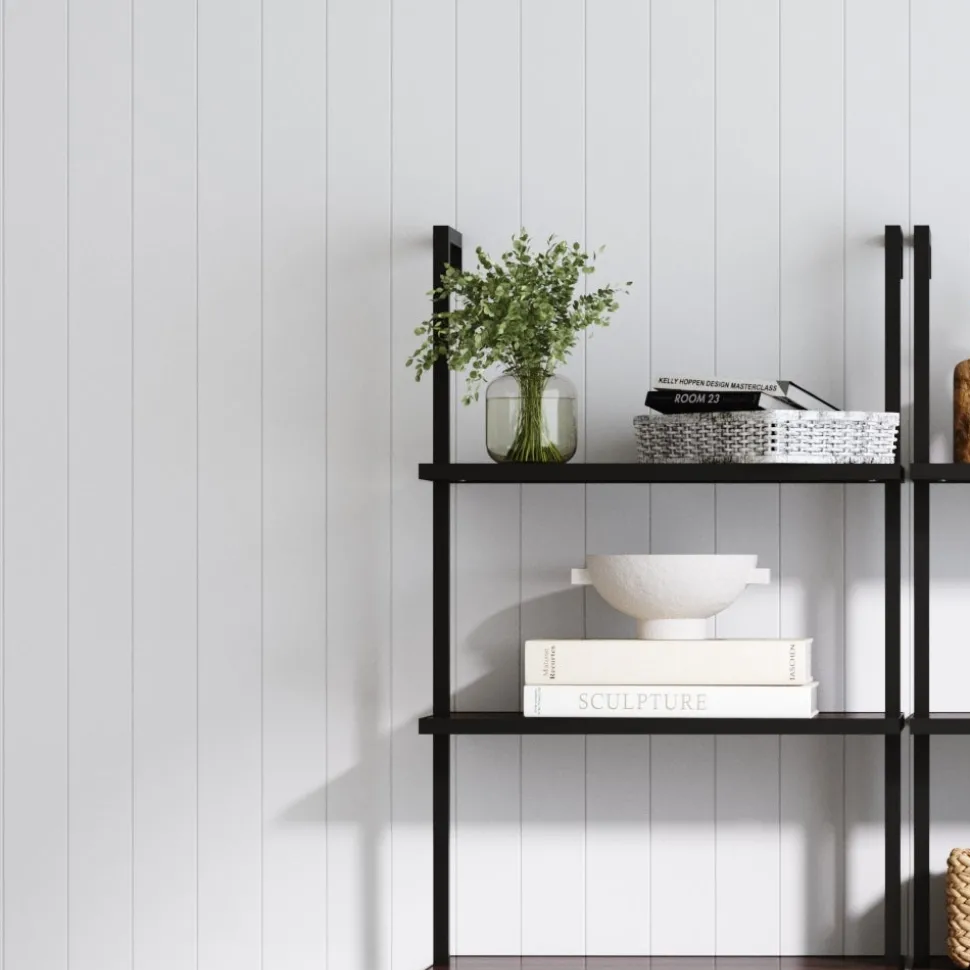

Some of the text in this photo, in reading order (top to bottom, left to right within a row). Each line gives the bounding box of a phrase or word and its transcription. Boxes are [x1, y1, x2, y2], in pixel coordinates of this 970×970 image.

[658, 377, 777, 392] KELLY HOPPEN DESIGN MASTERCLASS
[674, 393, 720, 404] ROOM 23
[578, 692, 707, 711] SCULPTURE
